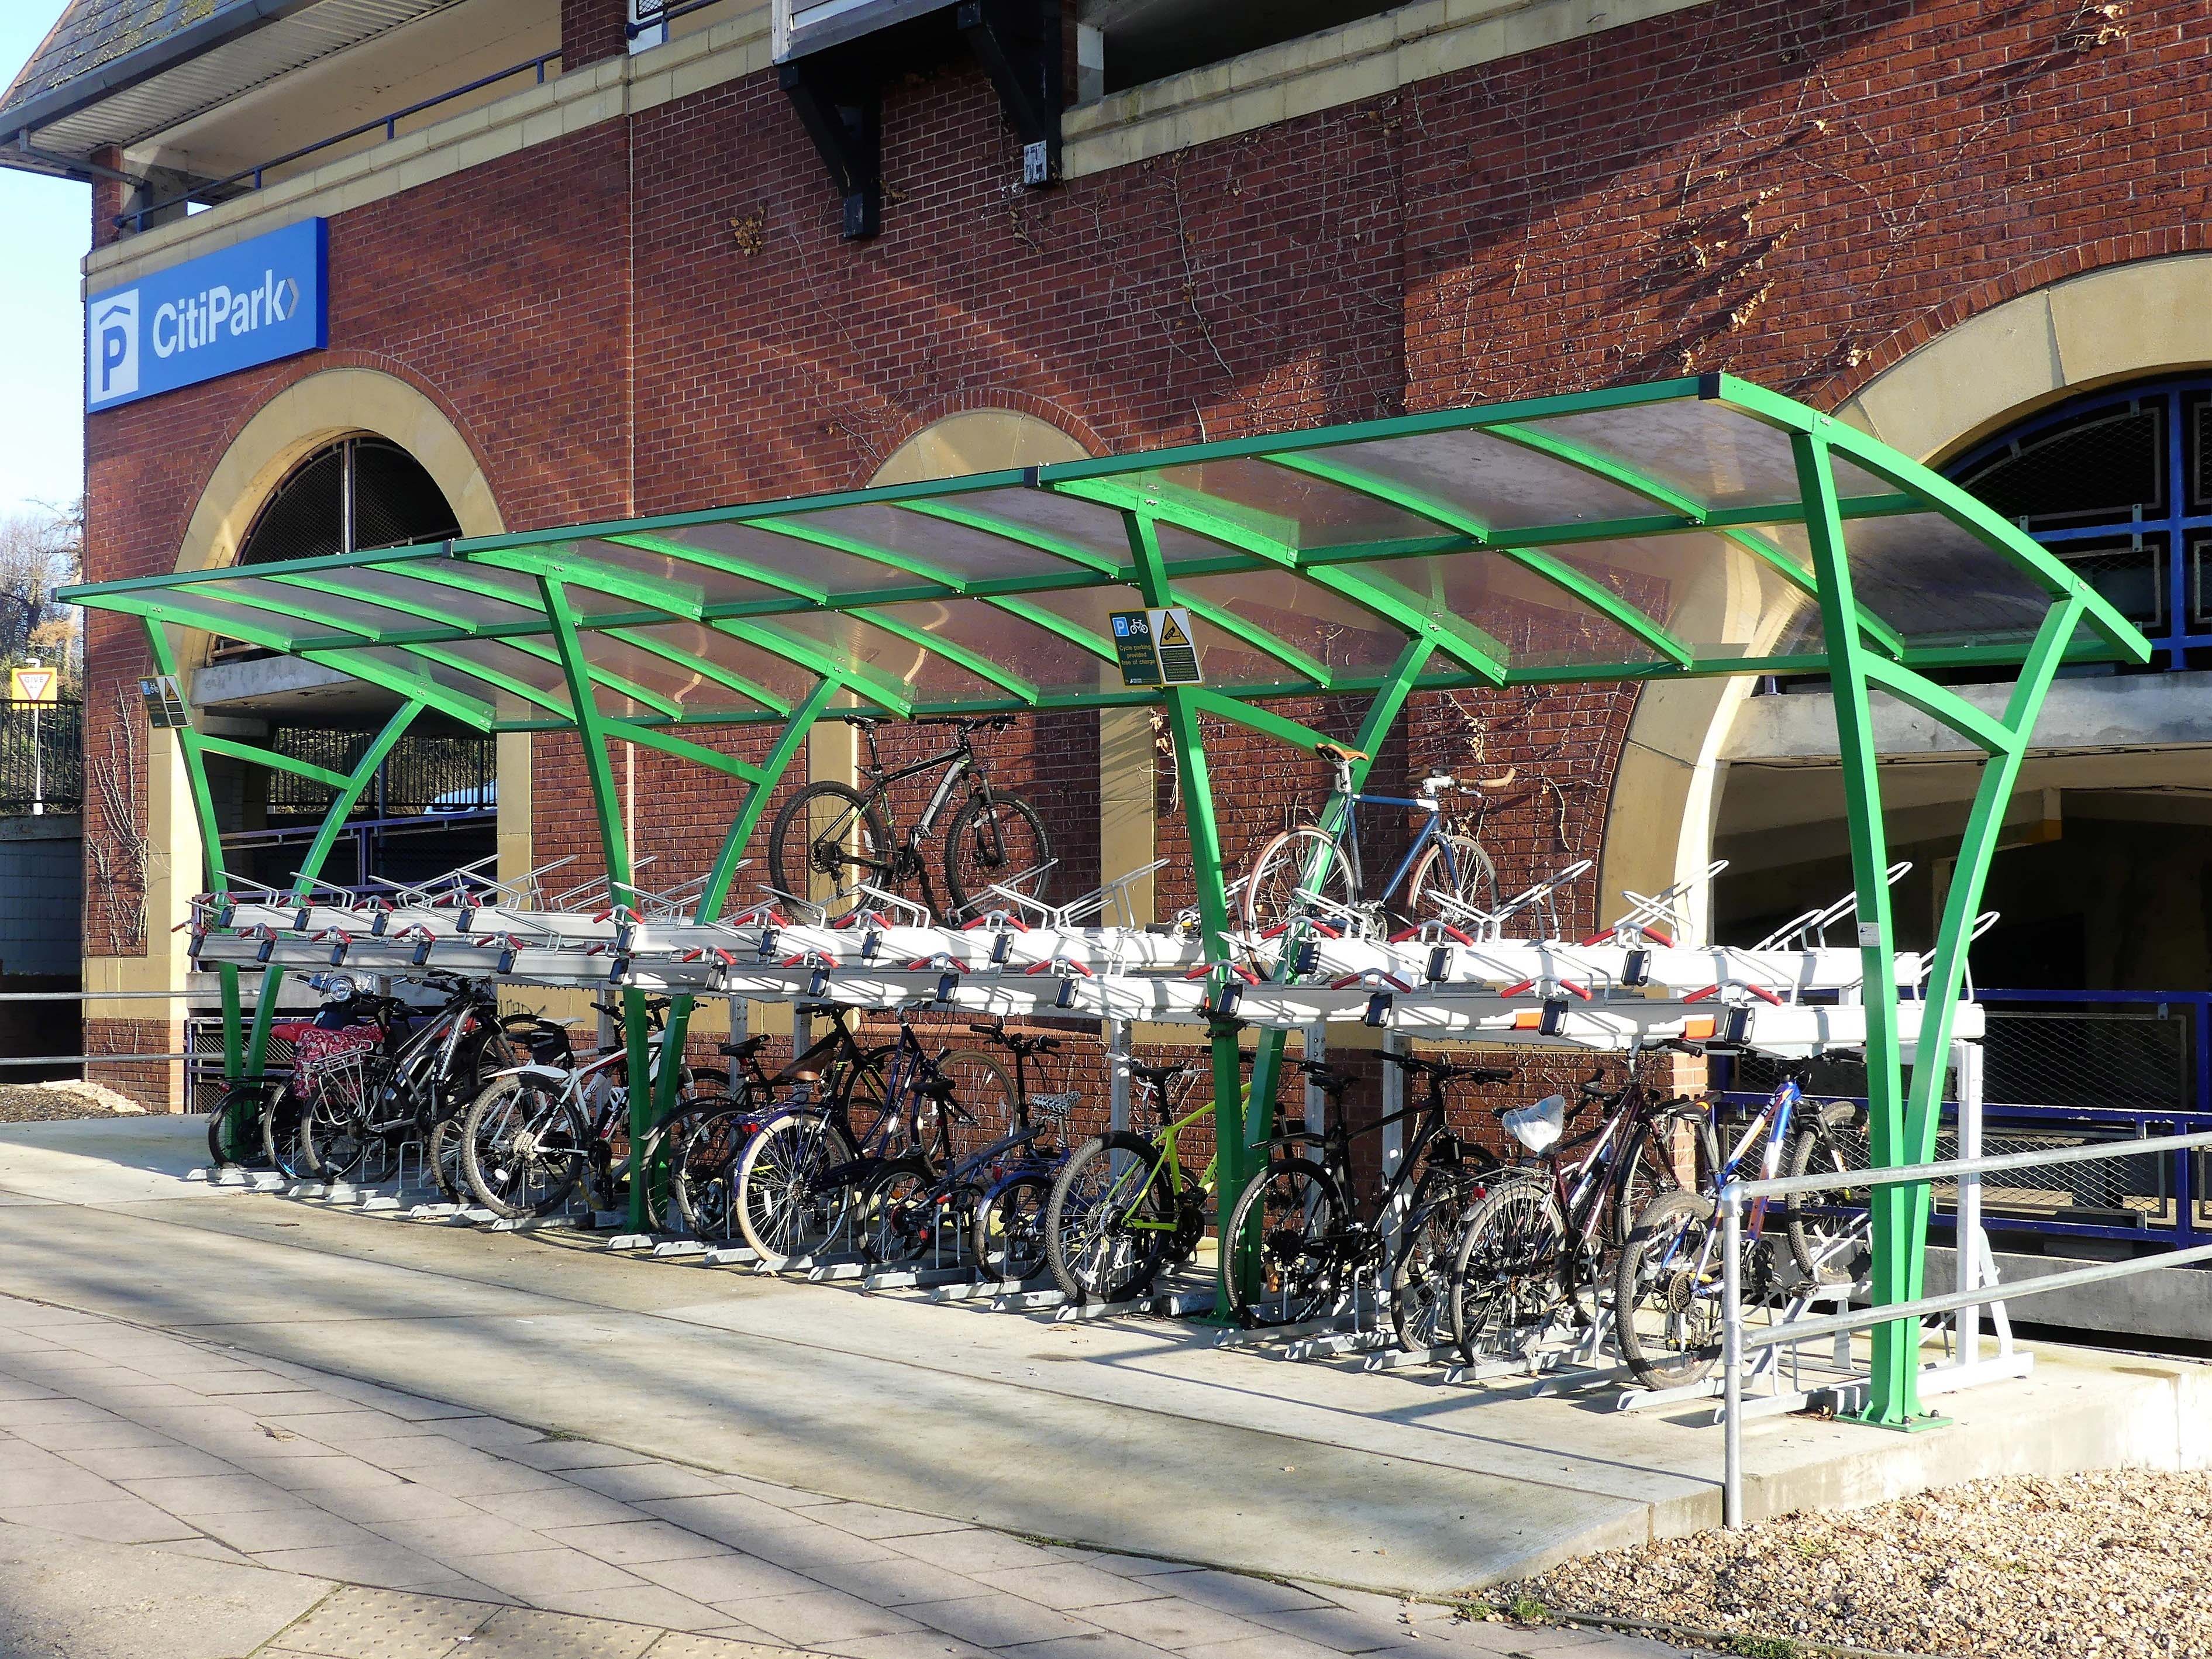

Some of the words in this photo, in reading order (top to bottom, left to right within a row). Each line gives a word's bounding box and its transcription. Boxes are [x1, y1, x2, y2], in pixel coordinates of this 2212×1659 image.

[153, 269, 287, 358] CitiPark
[102, 325, 128, 391] P
[1117, 621, 1124, 634] P
